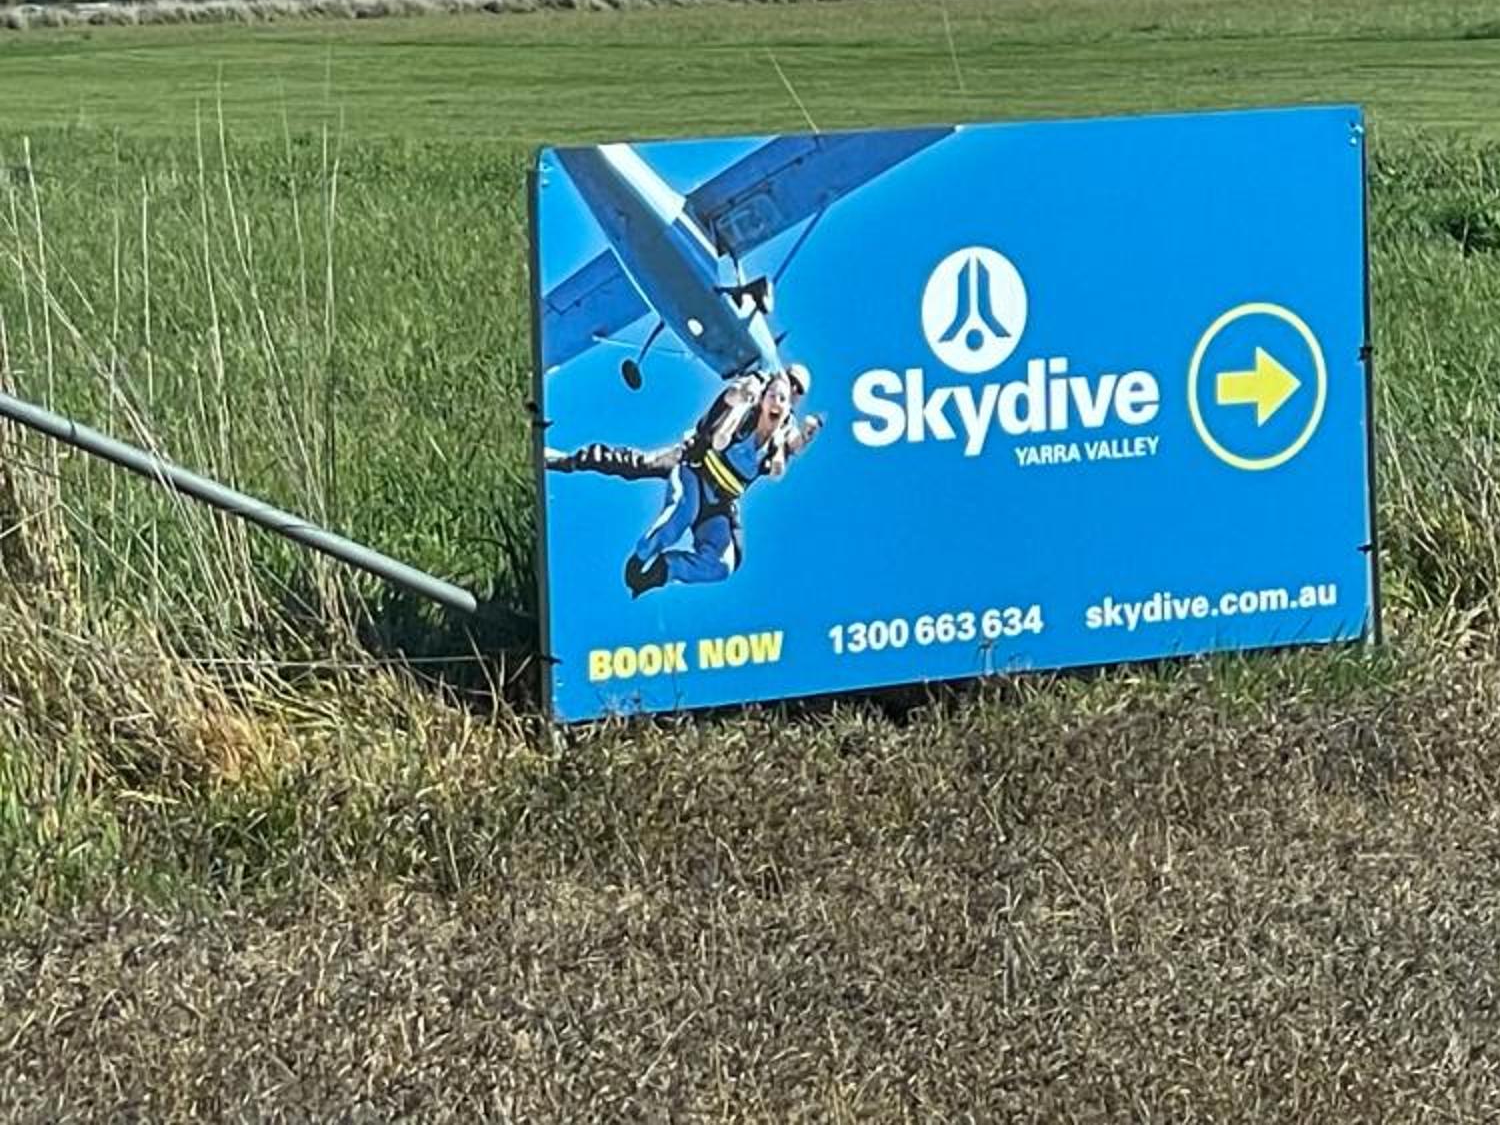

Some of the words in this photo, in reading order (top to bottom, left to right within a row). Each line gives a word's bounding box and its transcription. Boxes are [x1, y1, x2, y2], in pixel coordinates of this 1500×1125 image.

[851, 358, 1160, 456] Skydive
[1015, 443, 1081, 466] YARRA
[1084, 436, 1160, 461] VALLEY
[828, 618, 909, 654] 1300
[913, 611, 976, 646] 663
[981, 604, 1044, 639] 634
[1085, 582, 1338, 632] skydive.com.au
[588, 641, 688, 681] BOOK
[697, 631, 784, 672] NOW
